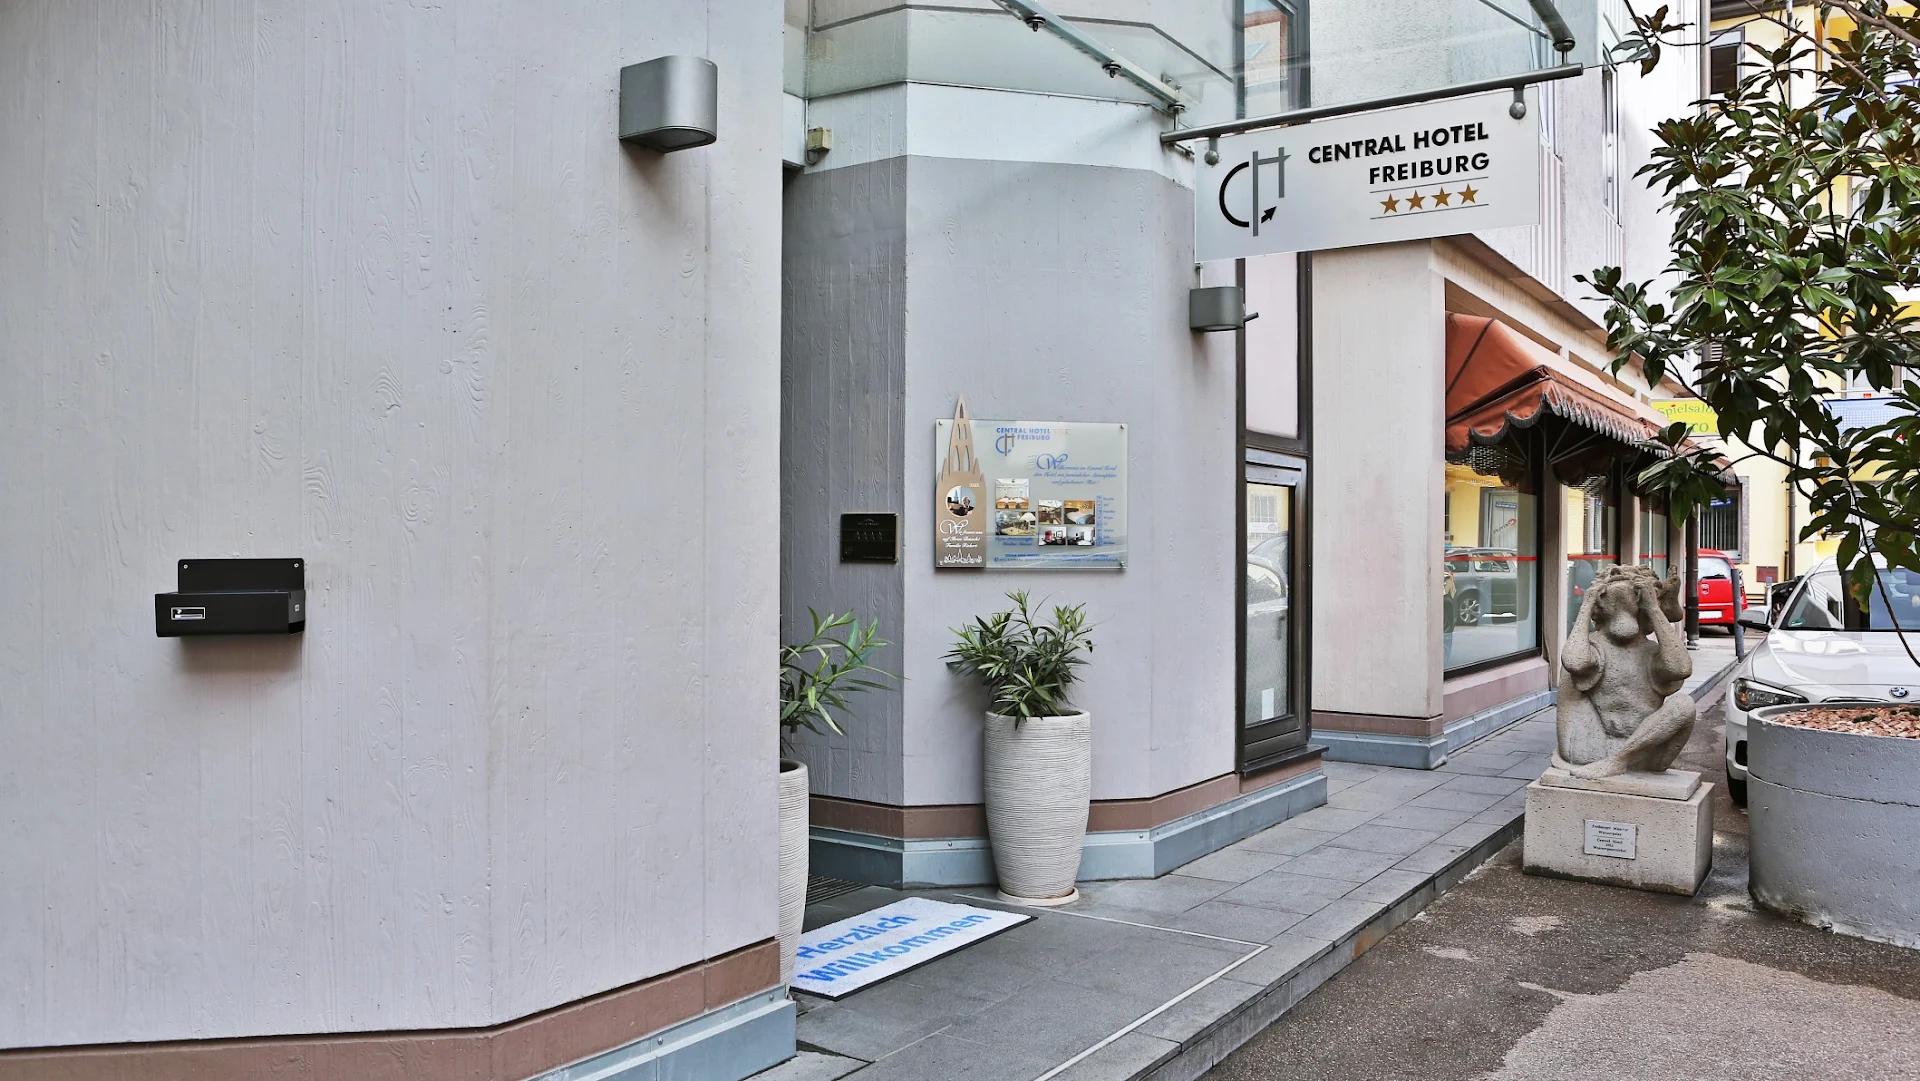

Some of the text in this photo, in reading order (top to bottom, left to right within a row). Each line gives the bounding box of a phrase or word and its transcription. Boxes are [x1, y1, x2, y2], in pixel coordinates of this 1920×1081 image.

[1308, 122, 1490, 164] CENTRAL HOTEL
[1369, 152, 1490, 185] FREIBURG
[1658, 403, 1716, 418] Spielsalo
[996, 427, 1027, 435] CENTRAL
[1016, 434, 1051, 442] FREIBURG
[796, 913, 919, 960] Herzlich
[798, 913, 993, 983] Willkommen
